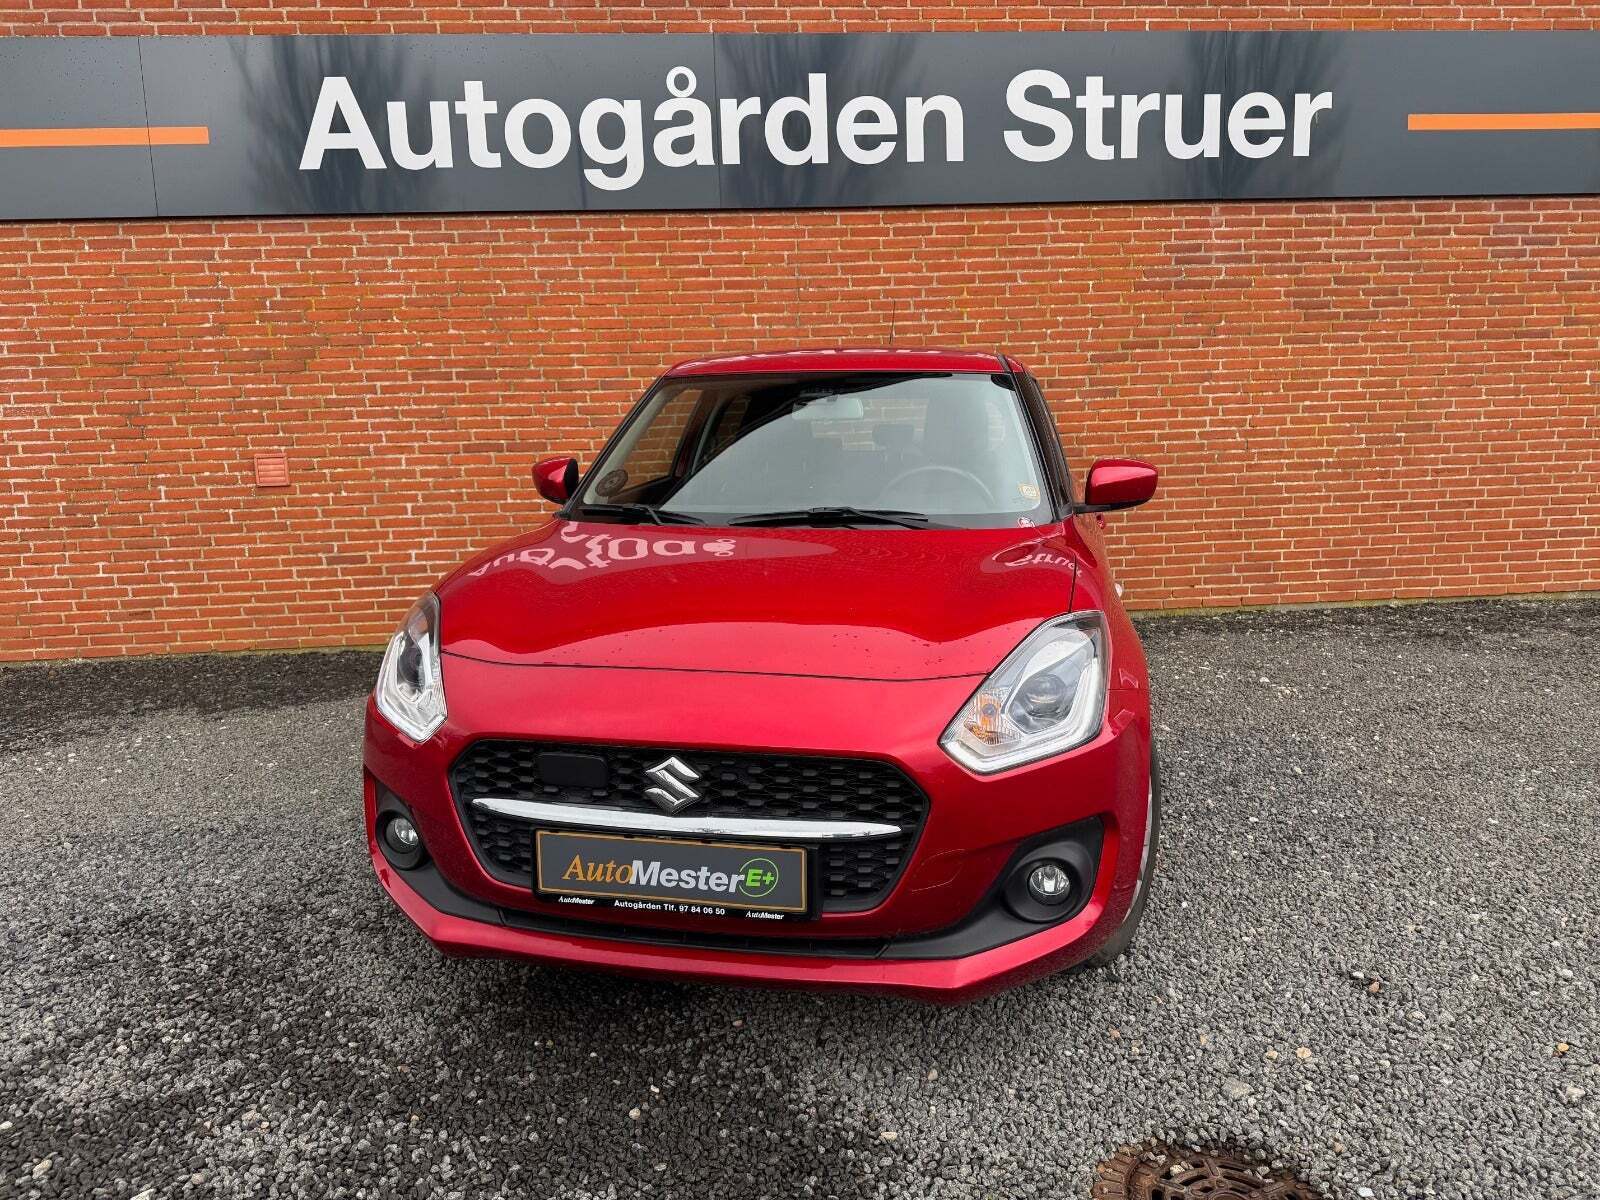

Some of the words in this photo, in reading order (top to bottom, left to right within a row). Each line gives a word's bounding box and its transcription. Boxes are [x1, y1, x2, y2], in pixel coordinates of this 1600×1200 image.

[299, 66, 964, 191] Autogården
[1003, 69, 1333, 162] Struer
[561, 854, 745, 893] AutoMester
[558, 896, 595, 905] AutoMester
[614, 900, 661, 910] Autogården
[663, 903, 677, 911] Tlf.
[745, 910, 785, 920] AutoMester
